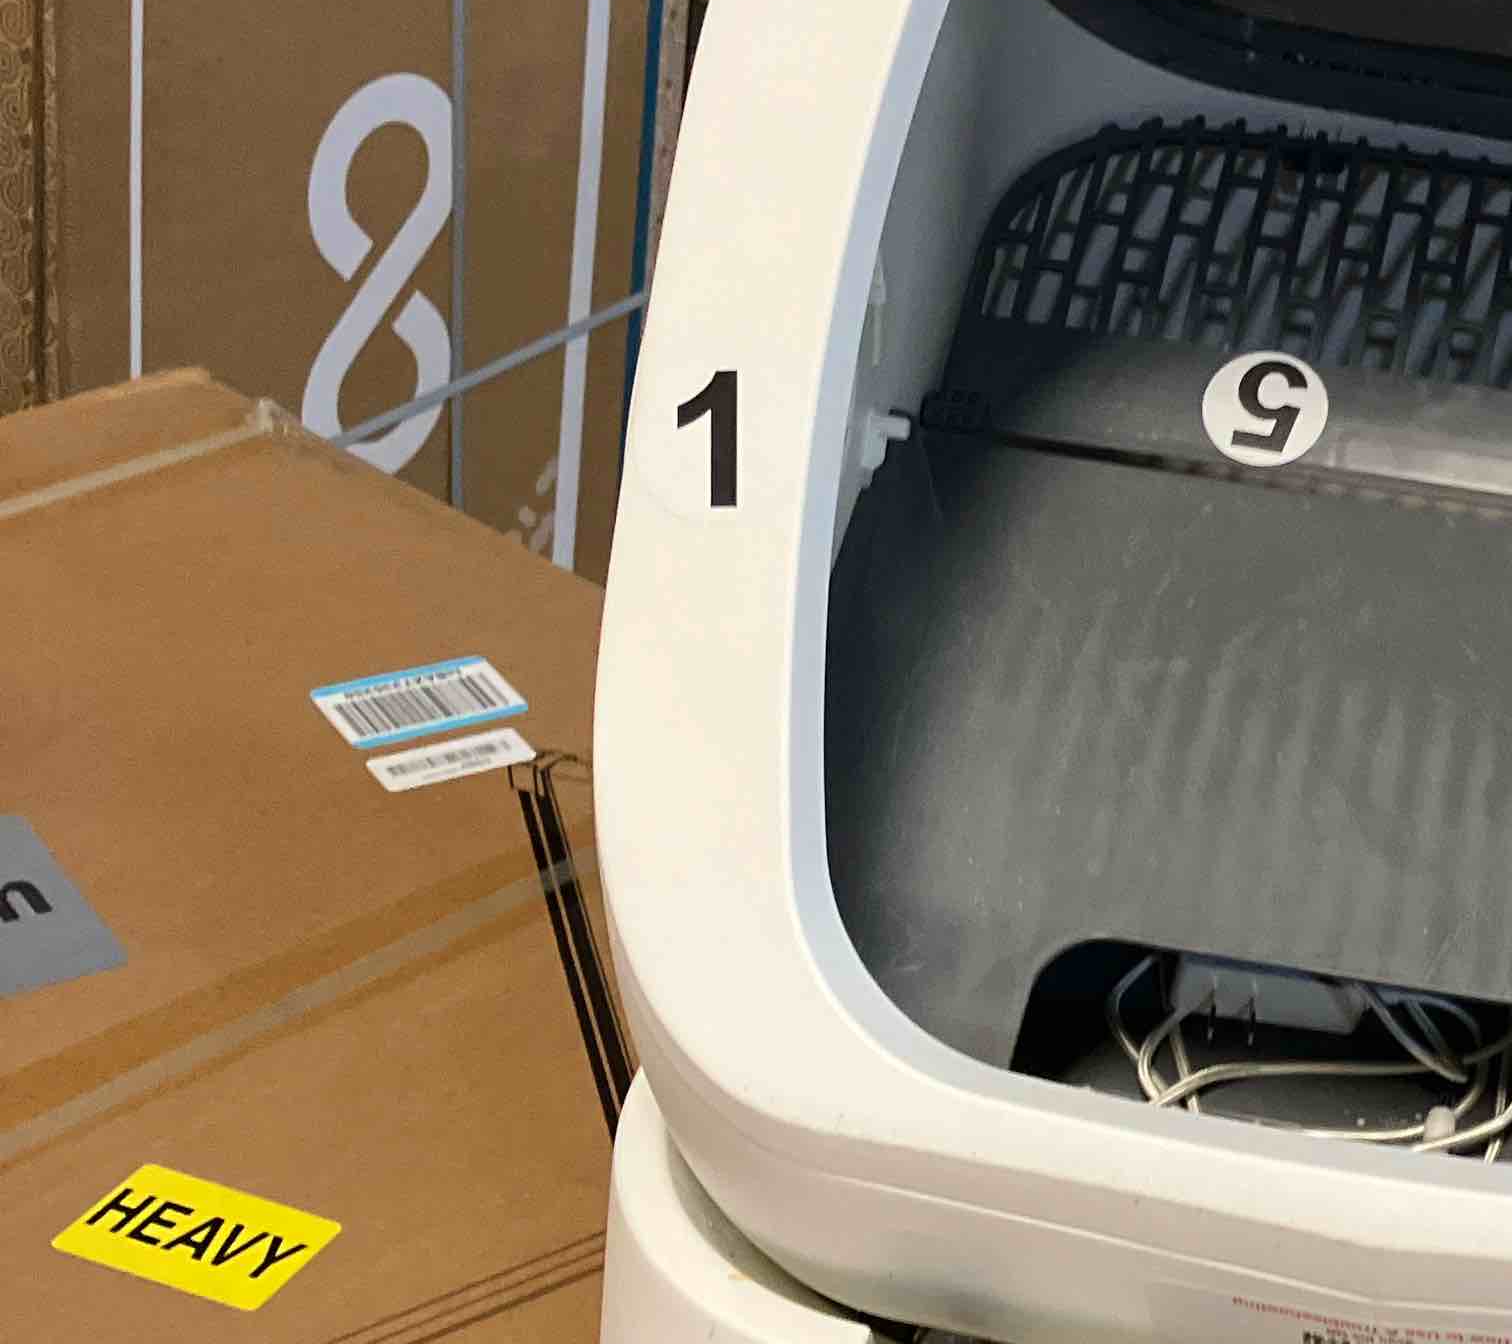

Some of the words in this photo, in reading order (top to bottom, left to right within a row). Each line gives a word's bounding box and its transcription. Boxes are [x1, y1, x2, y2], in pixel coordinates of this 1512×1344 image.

[676, 370, 740, 509] 1
[1231, 361, 1308, 455] 5
[86, 1186, 309, 1282] HEAVY
